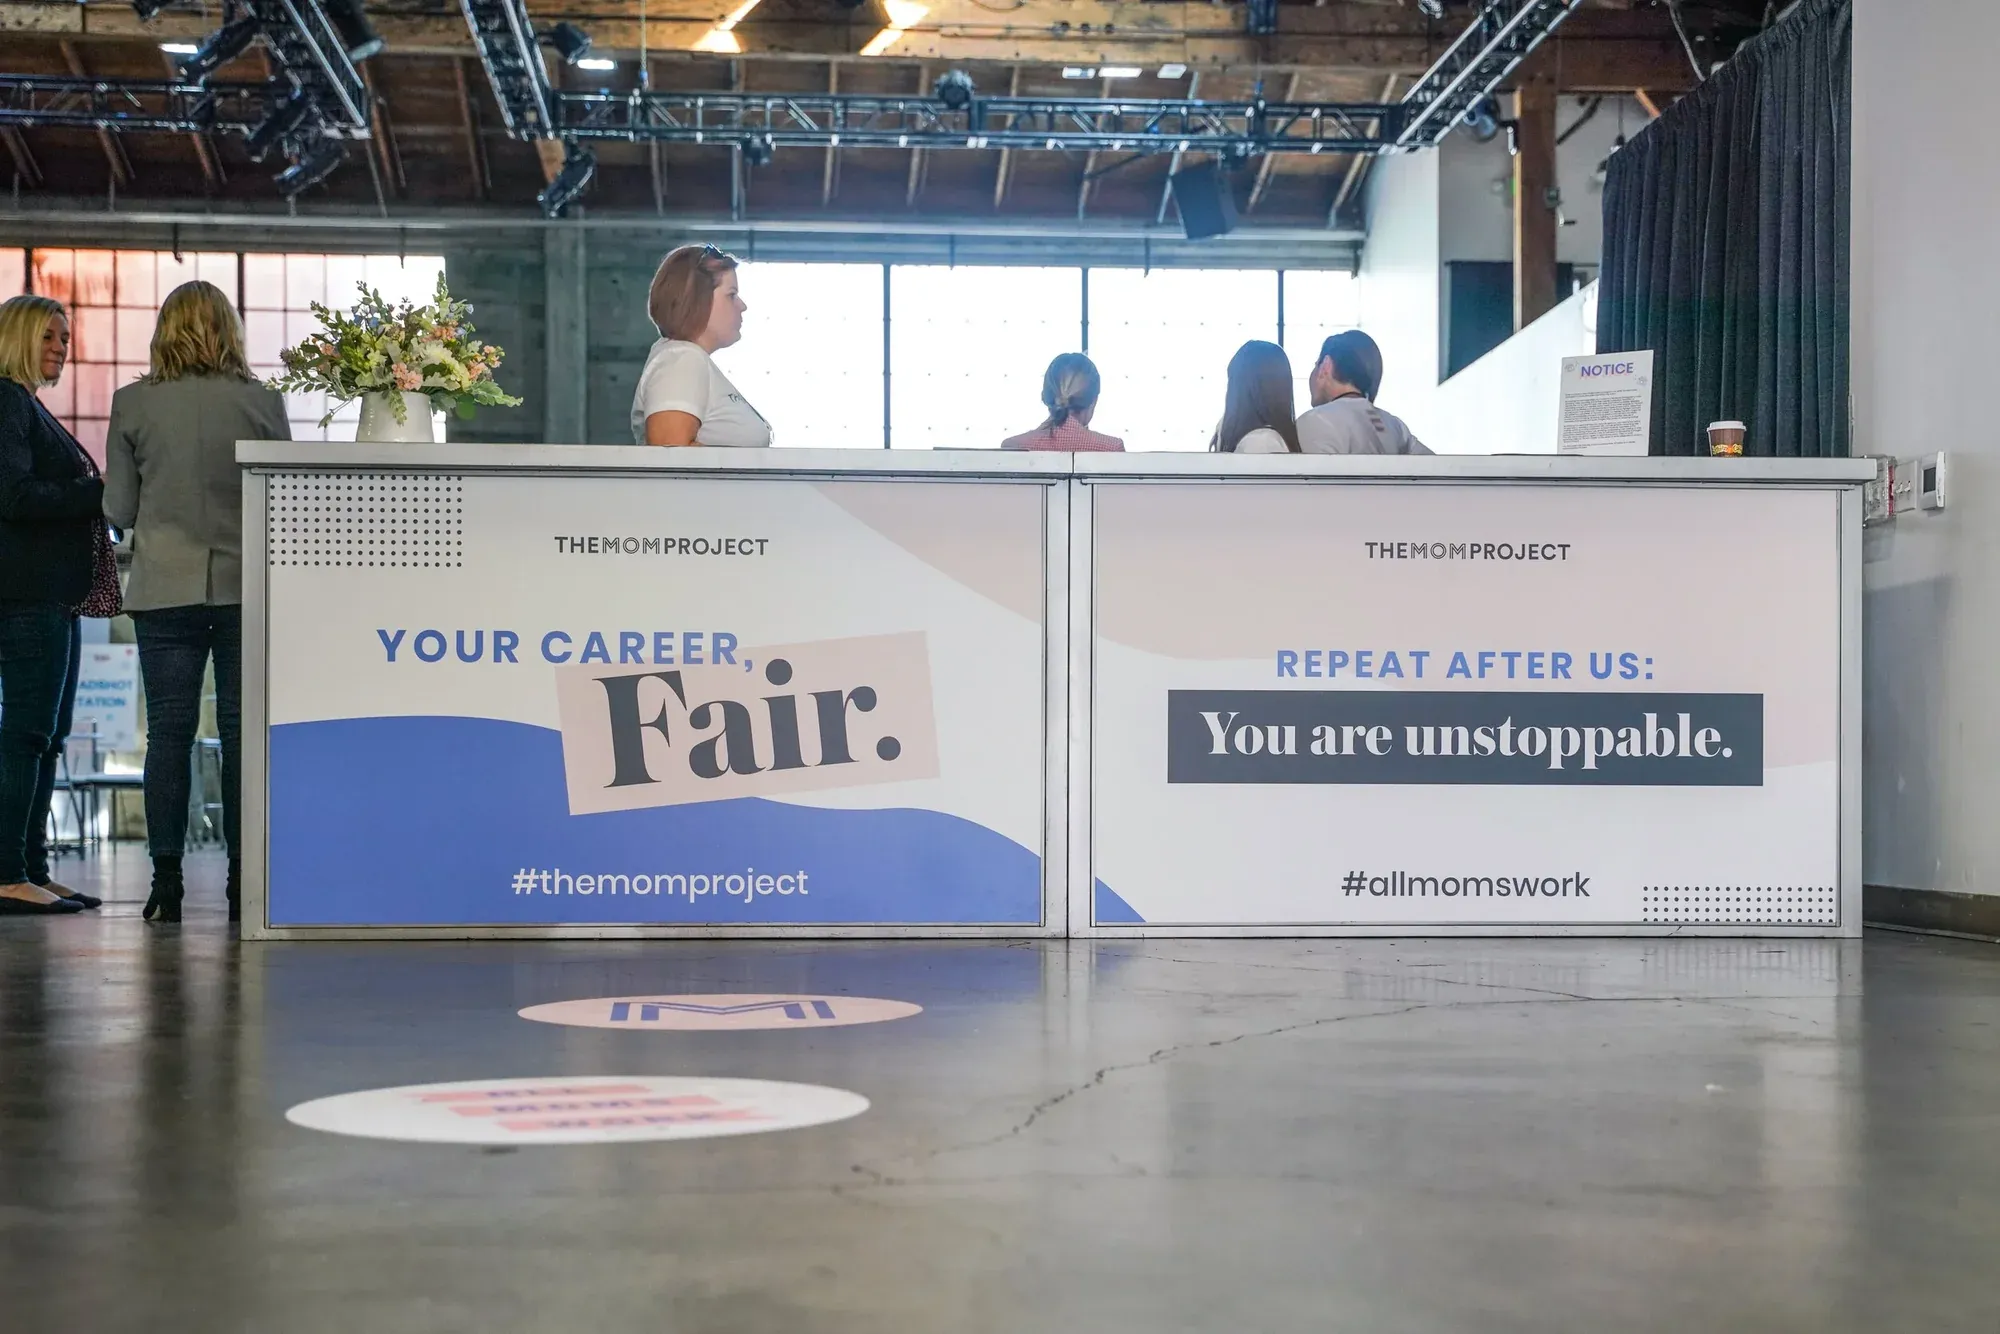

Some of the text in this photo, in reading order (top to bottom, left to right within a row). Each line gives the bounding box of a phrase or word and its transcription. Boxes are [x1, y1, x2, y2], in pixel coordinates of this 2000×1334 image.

[1581, 362, 1634, 377] NOTICE
[554, 536, 769, 556] THEMOMPROJECT
[1365, 541, 1571, 561] THEMOMPROJECT
[376, 629, 754, 673] YOUR CAREER,
[1278, 650, 1654, 680] REPEAT AFTER US:
[77, 696, 126, 706] TATION
[593, 658, 902, 789] Fair.
[1199, 711, 1733, 770] You are unstoppable.
[511, 867, 809, 904] #themomproject
[1341, 870, 1591, 897] #allmomswork
